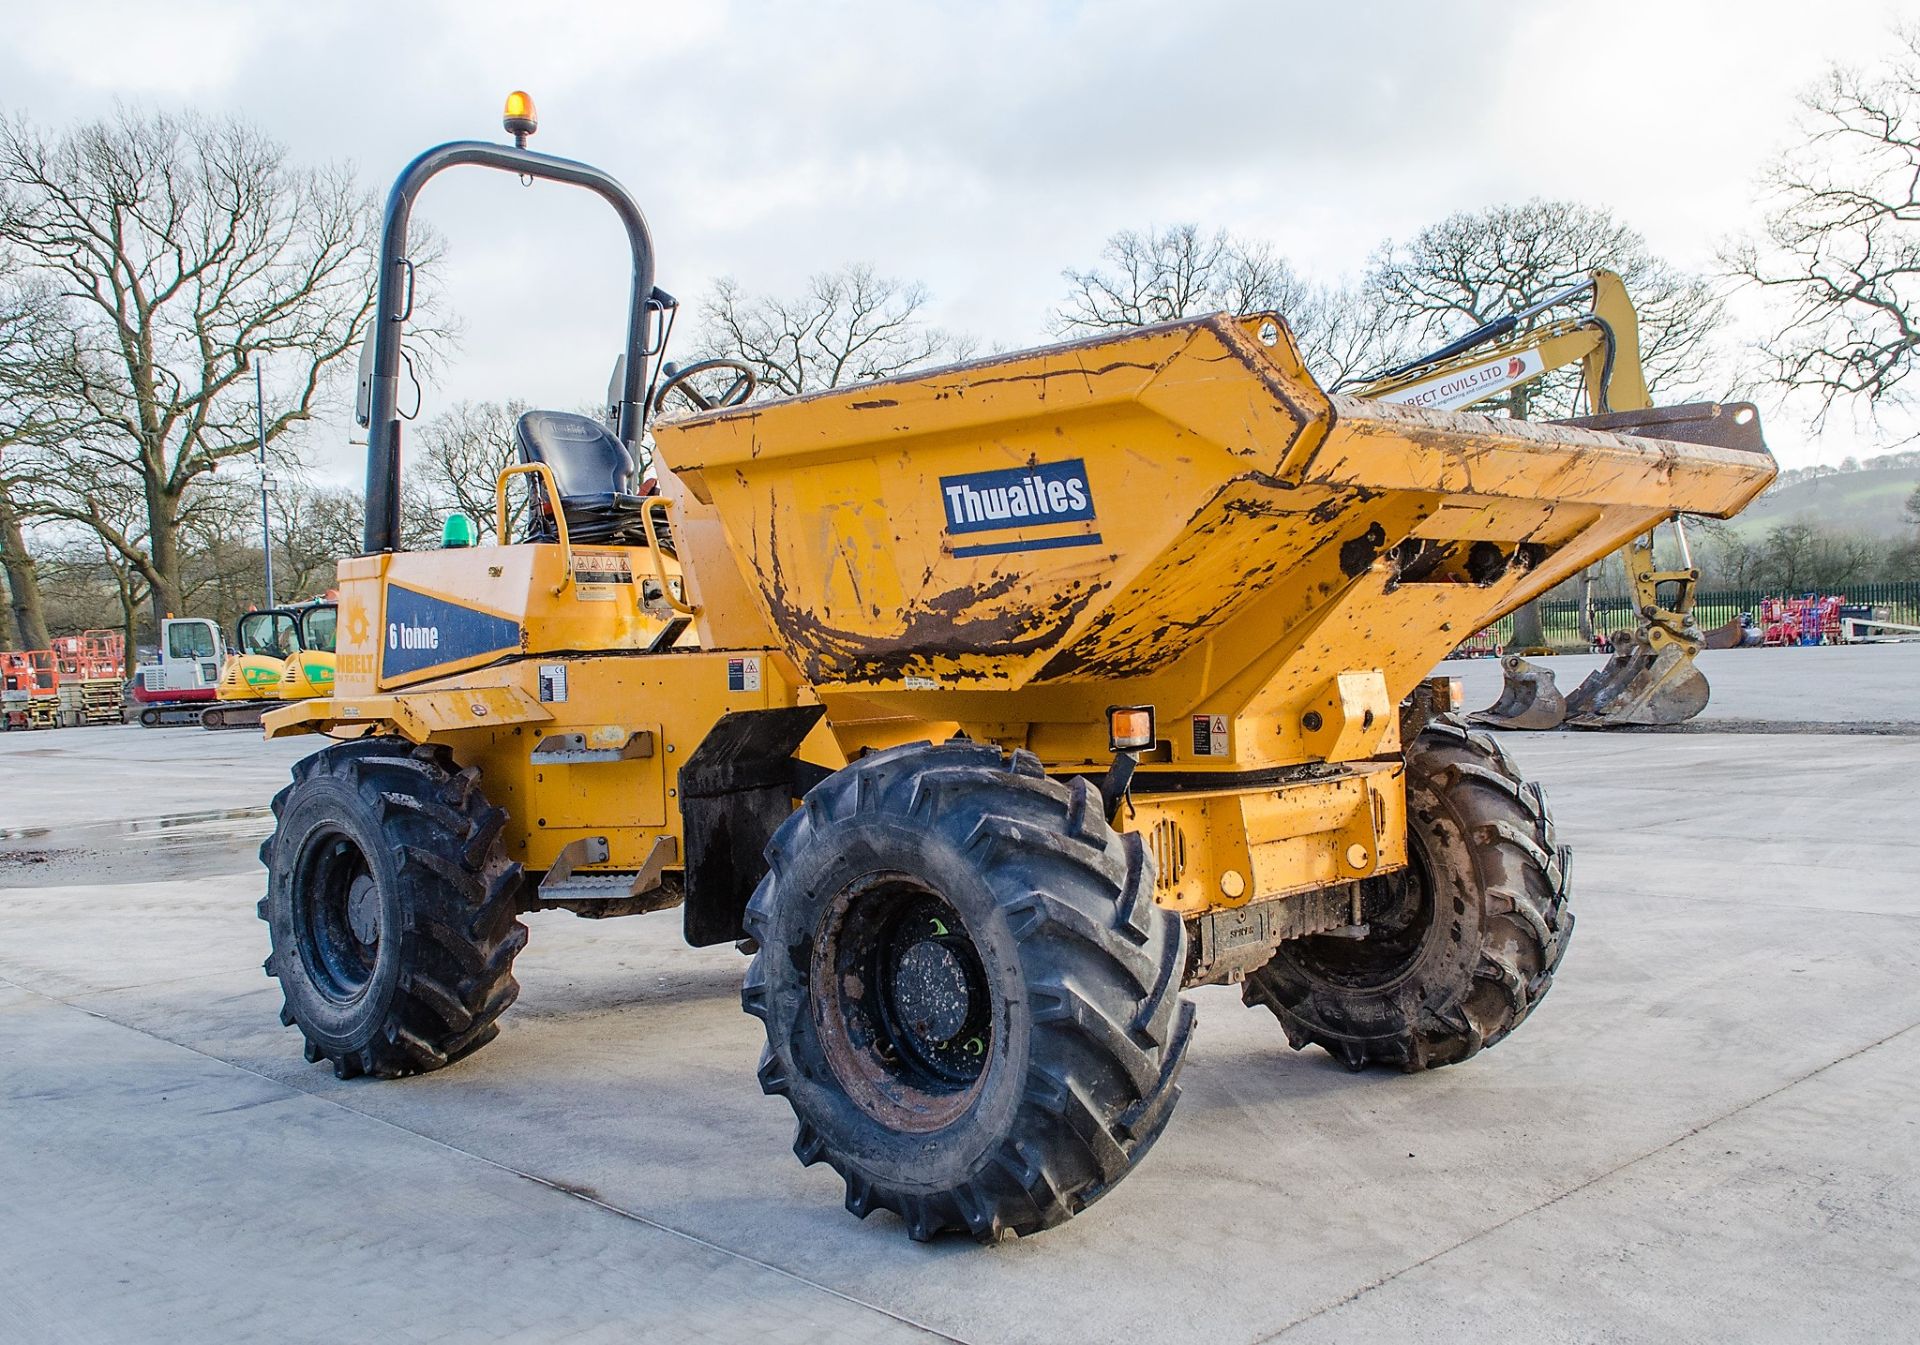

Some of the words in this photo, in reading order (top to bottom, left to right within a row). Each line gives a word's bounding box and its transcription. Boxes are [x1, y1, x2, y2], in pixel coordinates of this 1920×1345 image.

[1440, 374, 1478, 397] CIVILS
[1479, 365, 1502, 383] LTD
[945, 475, 1087, 524] Thwaites
[389, 623, 397, 650] 6
[400, 622, 439, 650] tonne
